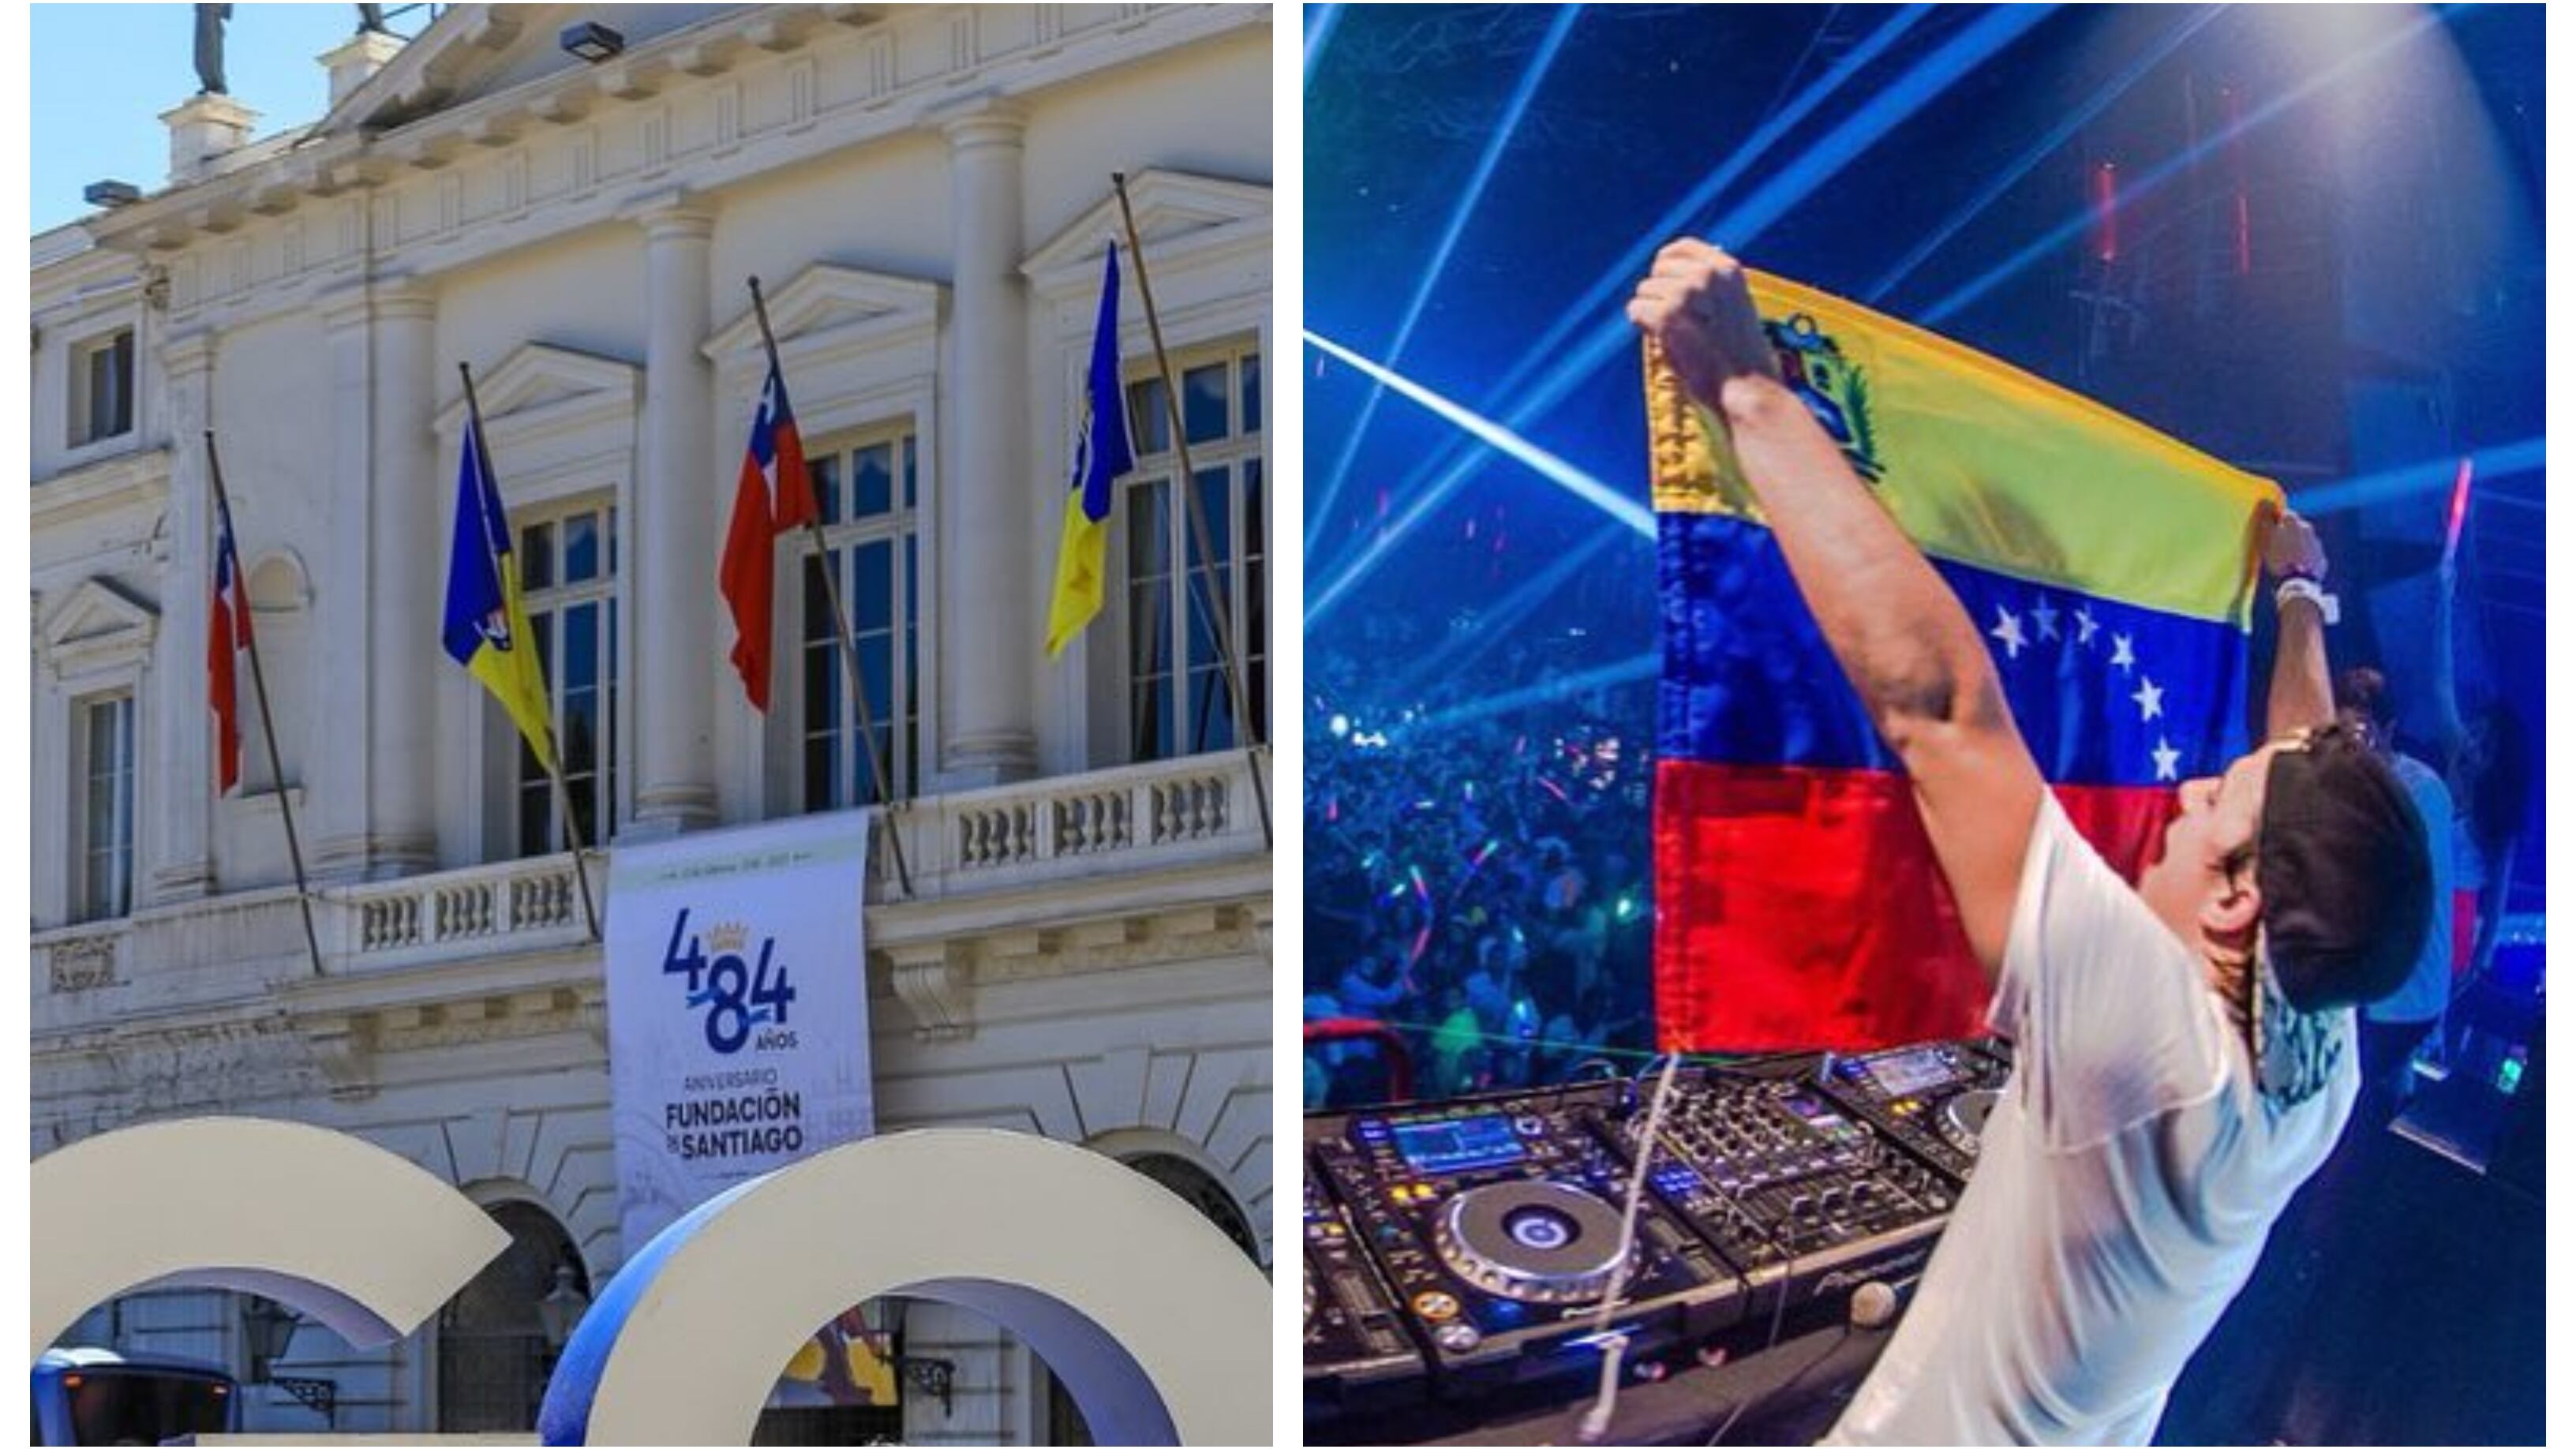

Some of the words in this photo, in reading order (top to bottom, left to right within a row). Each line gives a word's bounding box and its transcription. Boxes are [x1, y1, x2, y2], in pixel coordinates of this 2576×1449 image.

[664, 908, 796, 1054] 484
[666, 1087, 801, 1129] FUNDACIÓN
[681, 1125, 803, 1160] SANTIAGO
